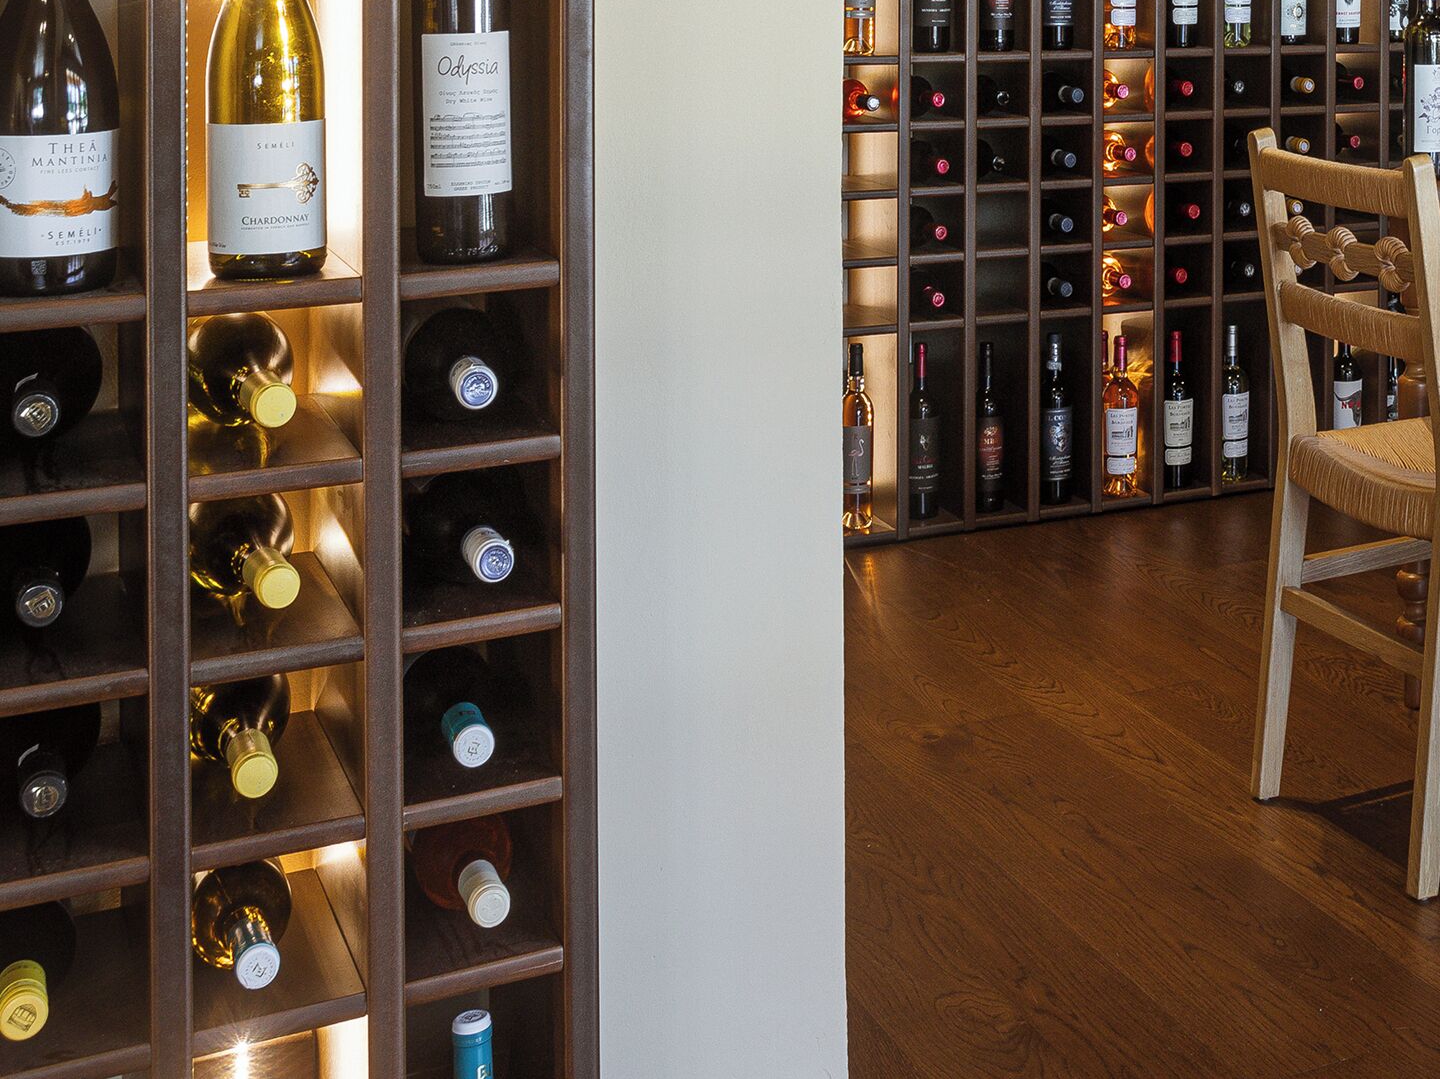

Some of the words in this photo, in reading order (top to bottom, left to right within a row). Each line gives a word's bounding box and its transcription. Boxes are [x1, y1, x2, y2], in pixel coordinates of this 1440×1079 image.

[437, 54, 499, 86] Odyssia
[32, 154, 108, 167] MANTINIA
[241, 213, 310, 226] CHARDONNAY
